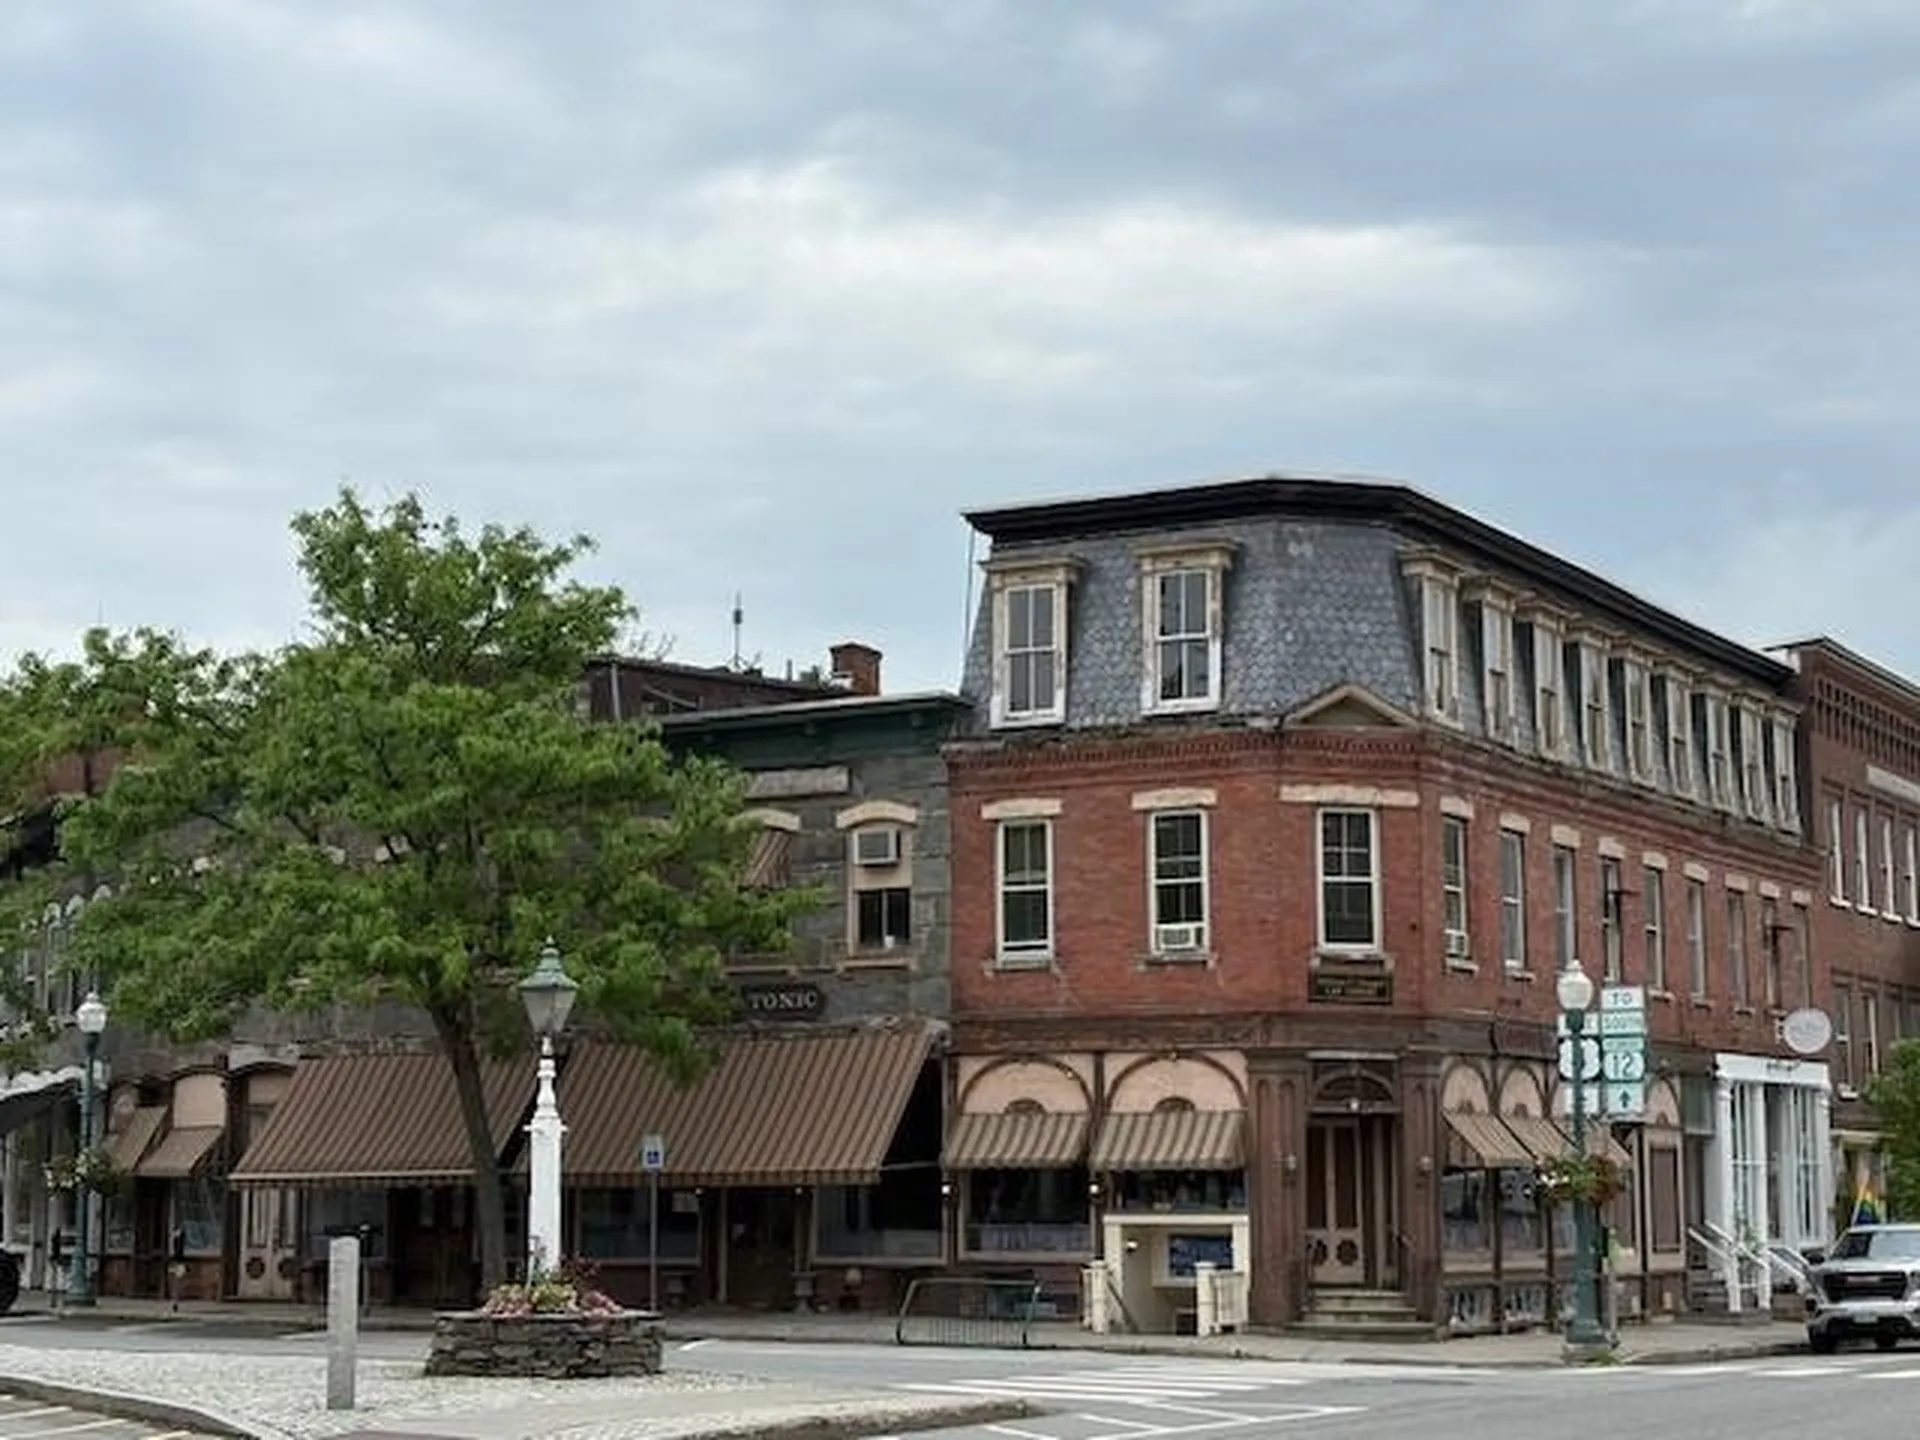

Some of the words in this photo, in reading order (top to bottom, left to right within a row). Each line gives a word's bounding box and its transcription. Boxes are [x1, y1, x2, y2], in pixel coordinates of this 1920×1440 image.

[747, 991, 818, 1010] TONIC
[1611, 991, 1633, 1006] TO
[1612, 1052, 1634, 1078] 12
